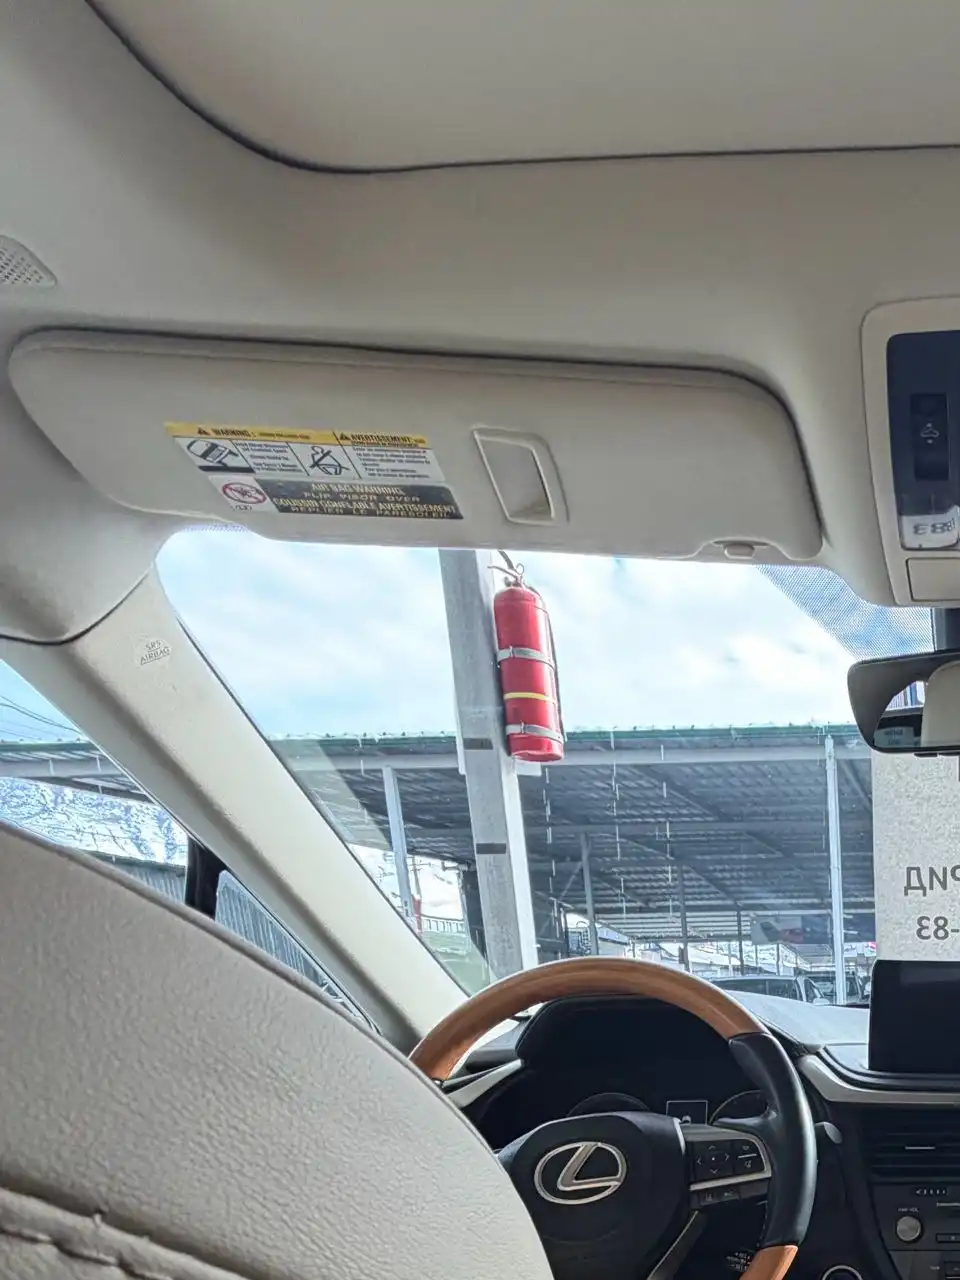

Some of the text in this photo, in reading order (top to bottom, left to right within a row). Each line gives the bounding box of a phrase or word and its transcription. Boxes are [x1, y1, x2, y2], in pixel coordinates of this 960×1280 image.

[353, 485, 405, 496] WARNING
[303, 491, 420, 503] FLIP VISOR OVER
[140, 646, 170, 666] AIRBAG
